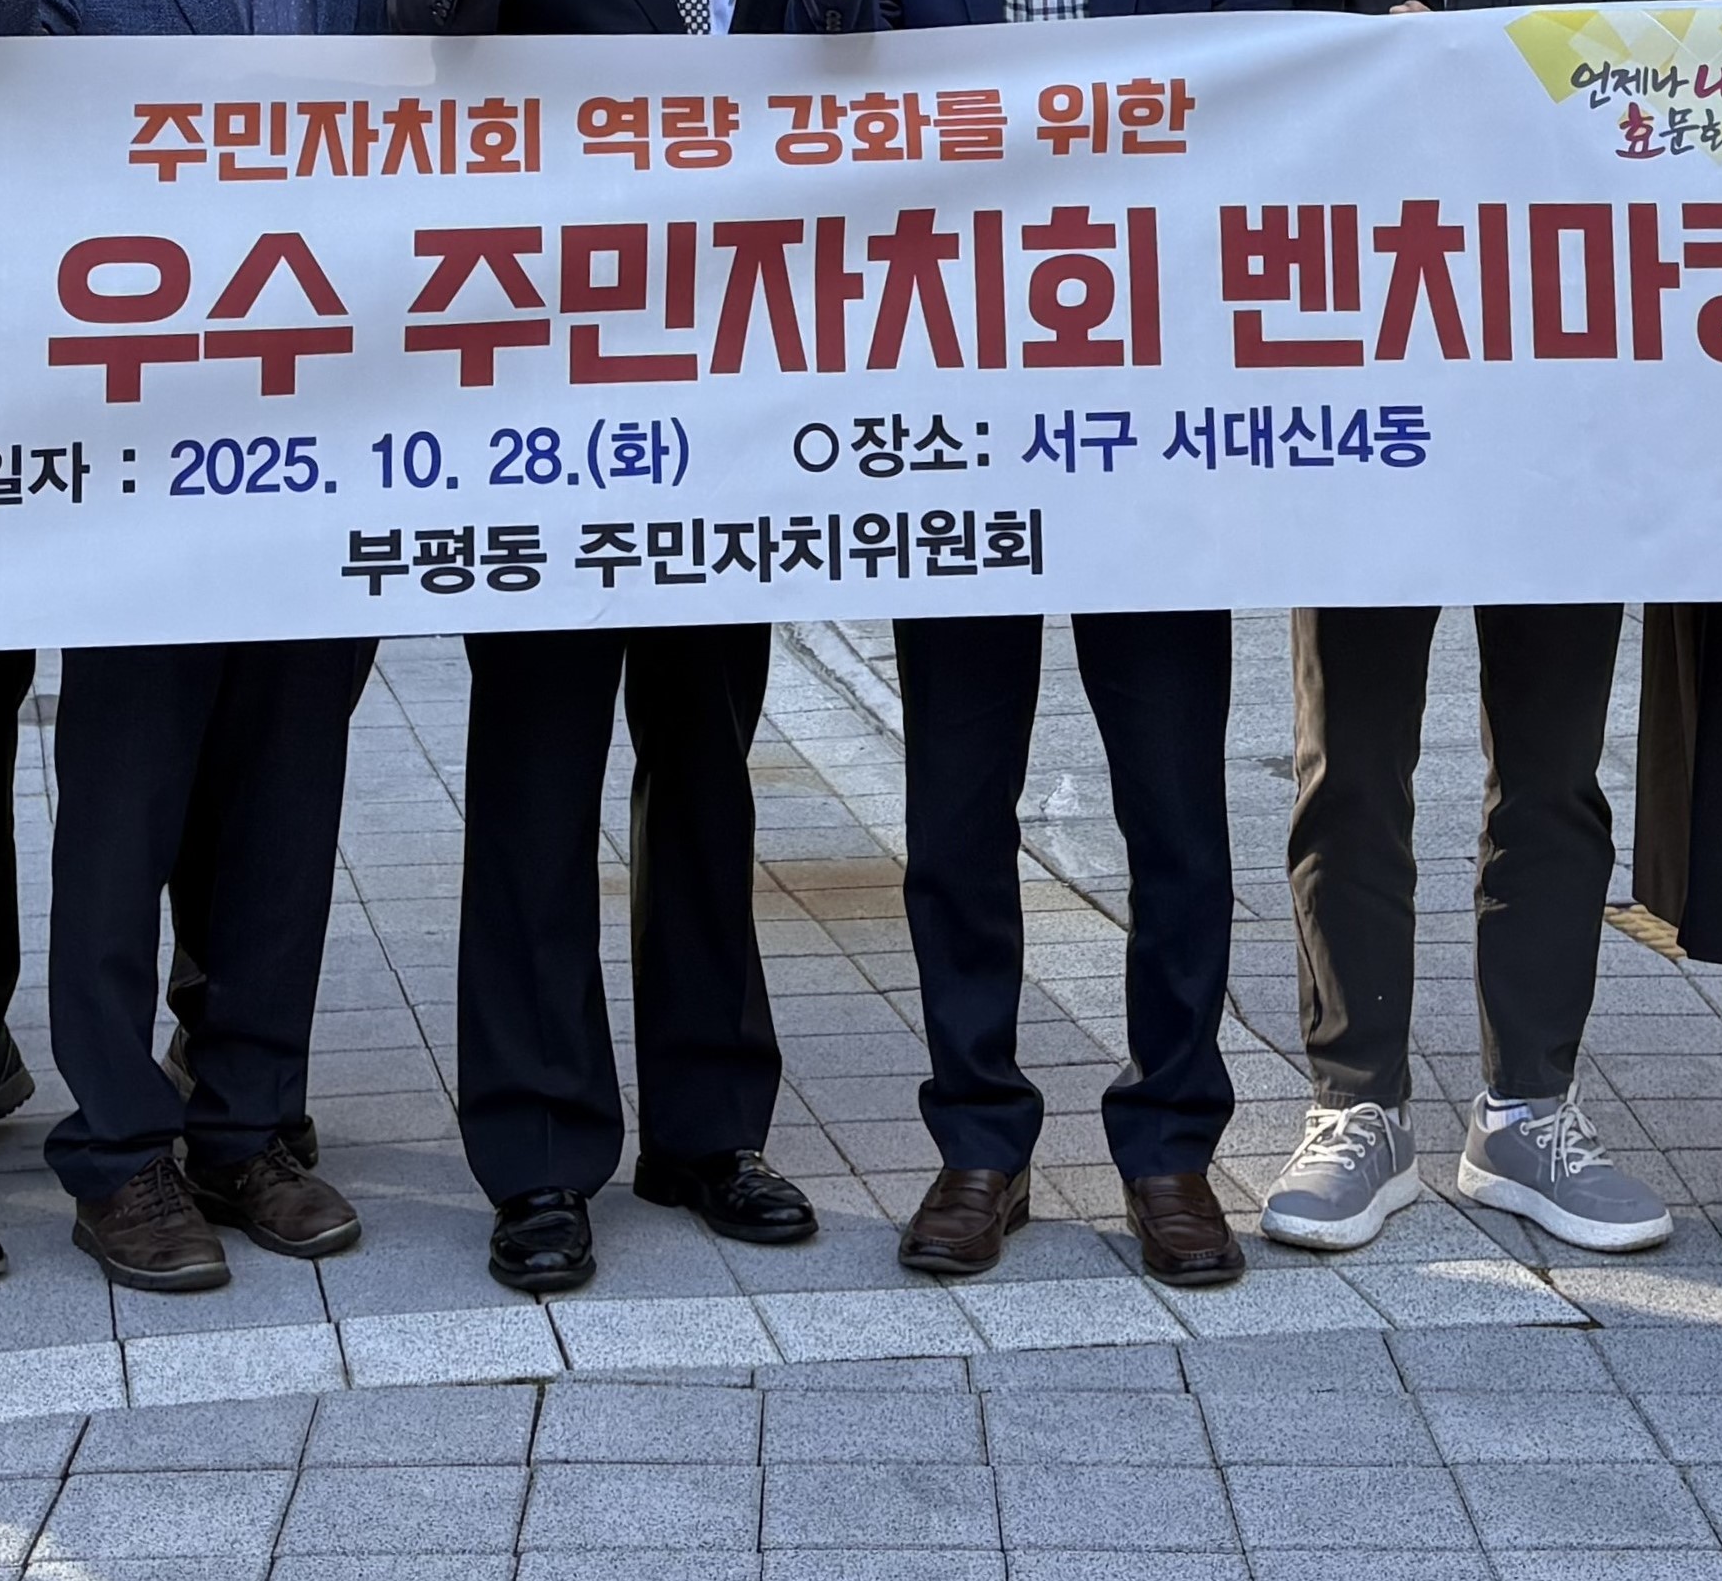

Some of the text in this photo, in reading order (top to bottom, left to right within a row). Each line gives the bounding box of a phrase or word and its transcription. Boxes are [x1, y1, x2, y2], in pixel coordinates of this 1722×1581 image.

[1570, 60, 1690, 110] 언제나
[128, 77, 1196, 182] 주민자치회 역량 강화를 위한
[48, 232, 354, 404] 우수
[403, 205, 1164, 388] 주민자치회
[169, 436, 338, 497] 2025.
[371, 430, 460, 490] 10.
[488, 417, 690, 490] 28.(화)
[1021, 409, 1138, 473] 서구
[1162, 404, 1432, 470] 서대신4동
[340, 508, 1044, 597] 부평동 주민자치위원회
